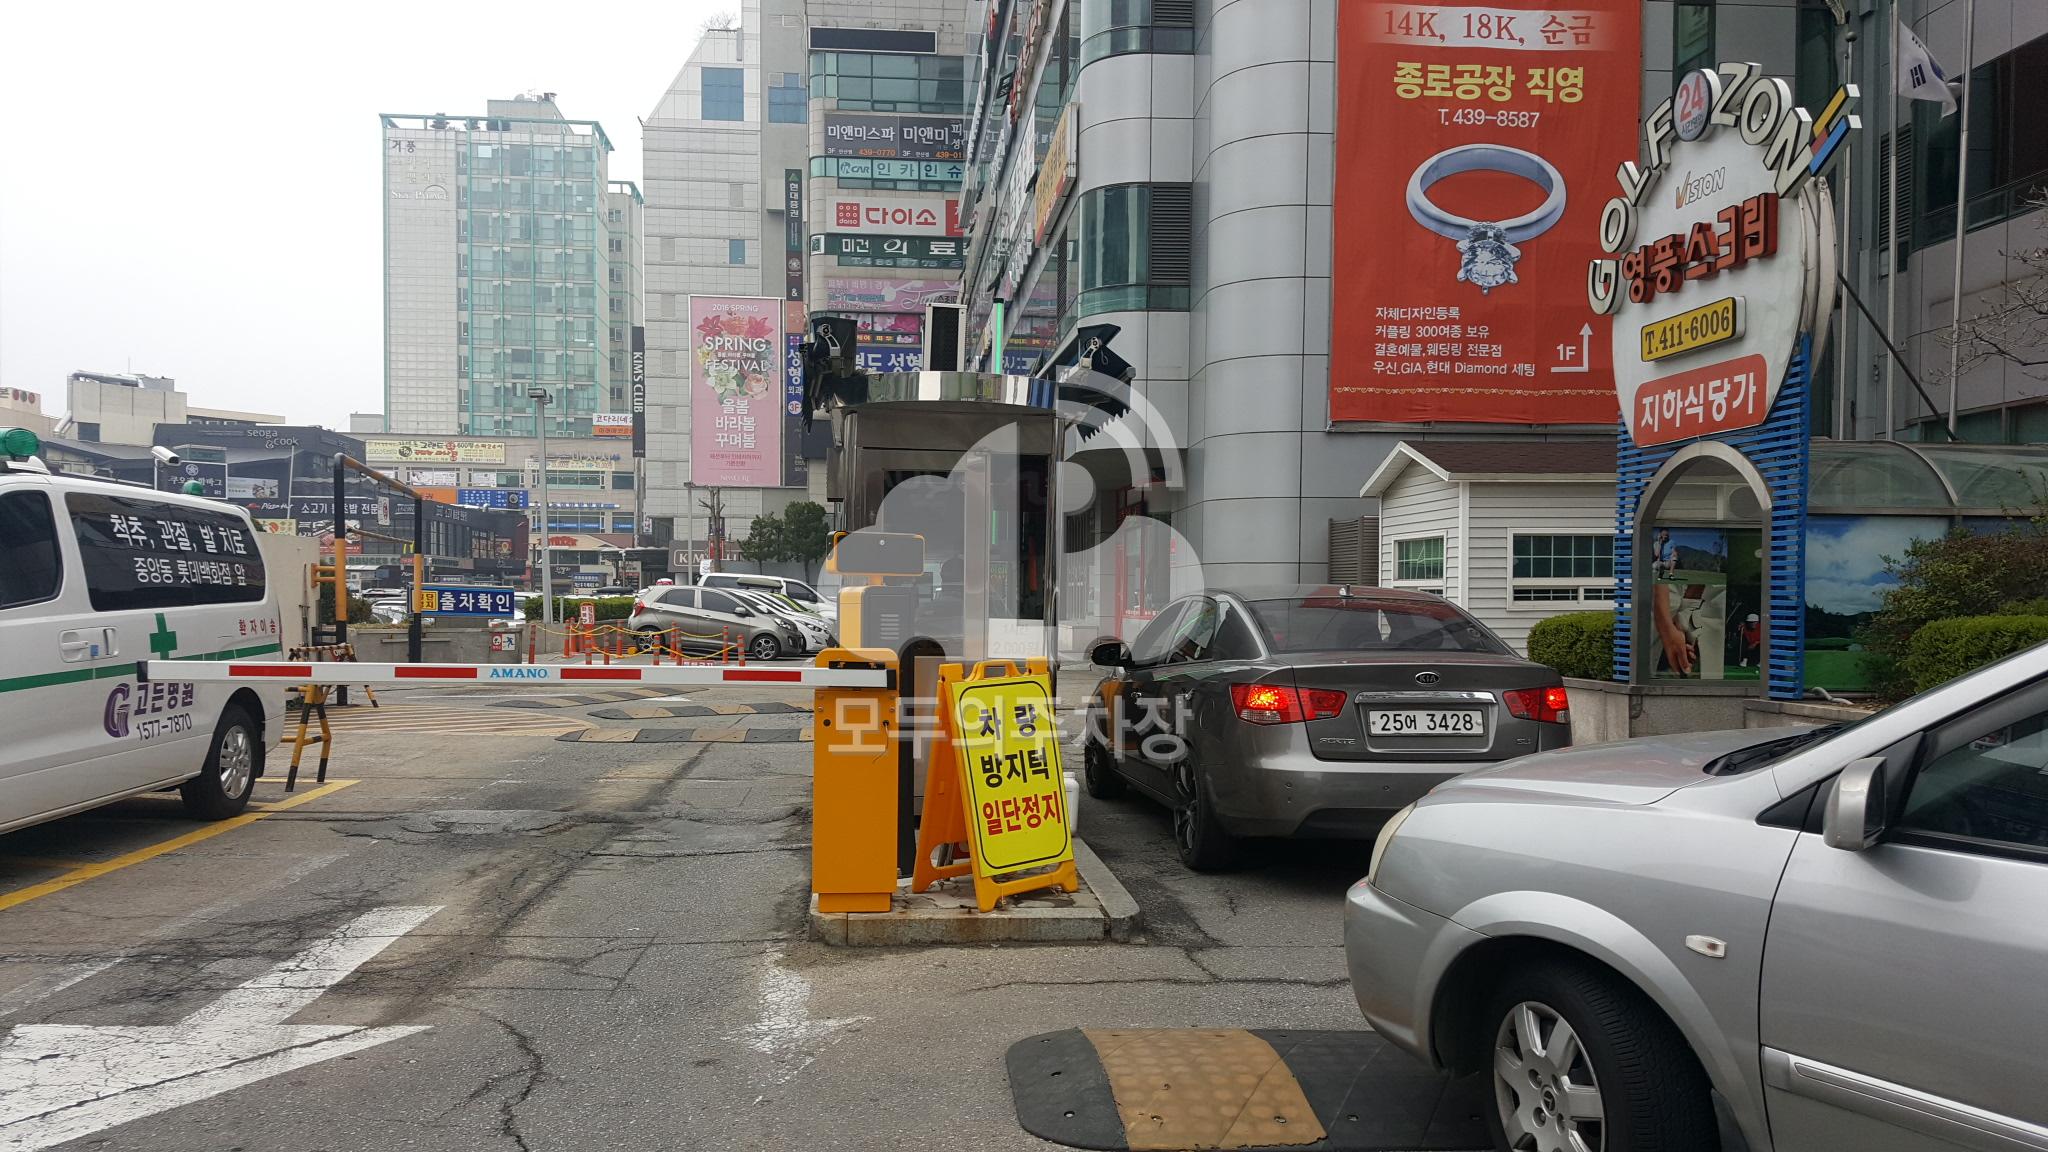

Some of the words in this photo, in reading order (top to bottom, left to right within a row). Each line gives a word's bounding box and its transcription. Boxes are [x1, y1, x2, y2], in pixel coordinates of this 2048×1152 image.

[1384, 9, 1446, 43] 14K,
[1462, 12, 1526, 46] 18K,
[1540, 14, 1596, 47] 순금
[1393, 61, 1515, 102] 종로공장
[1527, 65, 1585, 103] 직영
[1679, 74, 1705, 123] 24
[827, 124, 896, 142] 미앤미스파
[902, 126, 949, 145] 미앤미
[858, 149, 897, 157] 439-0770
[789, 183, 799, 217] 현대증권
[865, 207, 937, 226] 다이소
[842, 238, 869, 253] 미건
[731, 304, 759, 313] SPRING
[1375, 306, 1461, 321] 자체디자인등록
[1375, 325, 1411, 339] 커플링
[1415, 325, 1462, 339] 300여종
[1466, 325, 1490, 339] 보유
[705, 337, 767, 351] SPRING
[1467, 343, 1502, 358] 전문점
[1556, 345, 1576, 362] 1F
[633, 352, 643, 381] KIMS
[705, 359, 767, 372] FESTIVAL
[1455, 362, 1507, 375] Diamond
[1511, 363, 1536, 377] 세팅
[633, 384, 643, 413] CLUB
[721, 399, 750, 415] 올봄
[789, 403, 800, 412] 3F
[1640, 371, 1758, 433] 지하식당가
[715, 416, 757, 432] 바라봄
[247, 429, 278, 439] seoga
[715, 433, 757, 449] 꾸며봄
[301, 503, 328, 515] 소고기
[108, 513, 155, 549] 척추,
[158, 519, 198, 554] 관절,
[199, 523, 219, 554] 발
[219, 526, 248, 556] 치료
[134, 557, 173, 584] 중앙동
[176, 559, 233, 586] 롯데백화점
[235, 563, 248, 587] 앞
[439, 591, 511, 613] 출차확인
[238, 617, 278, 637] 환자이송
[490, 667, 549, 679] AMANO
[136, 713, 192, 741] 1577-7870
[1379, 713, 1417, 732] 25어
[1426, 713, 1474, 732] 3428
[981, 747, 1051, 789] 방지턱
[982, 790, 1062, 837] 일단정지
